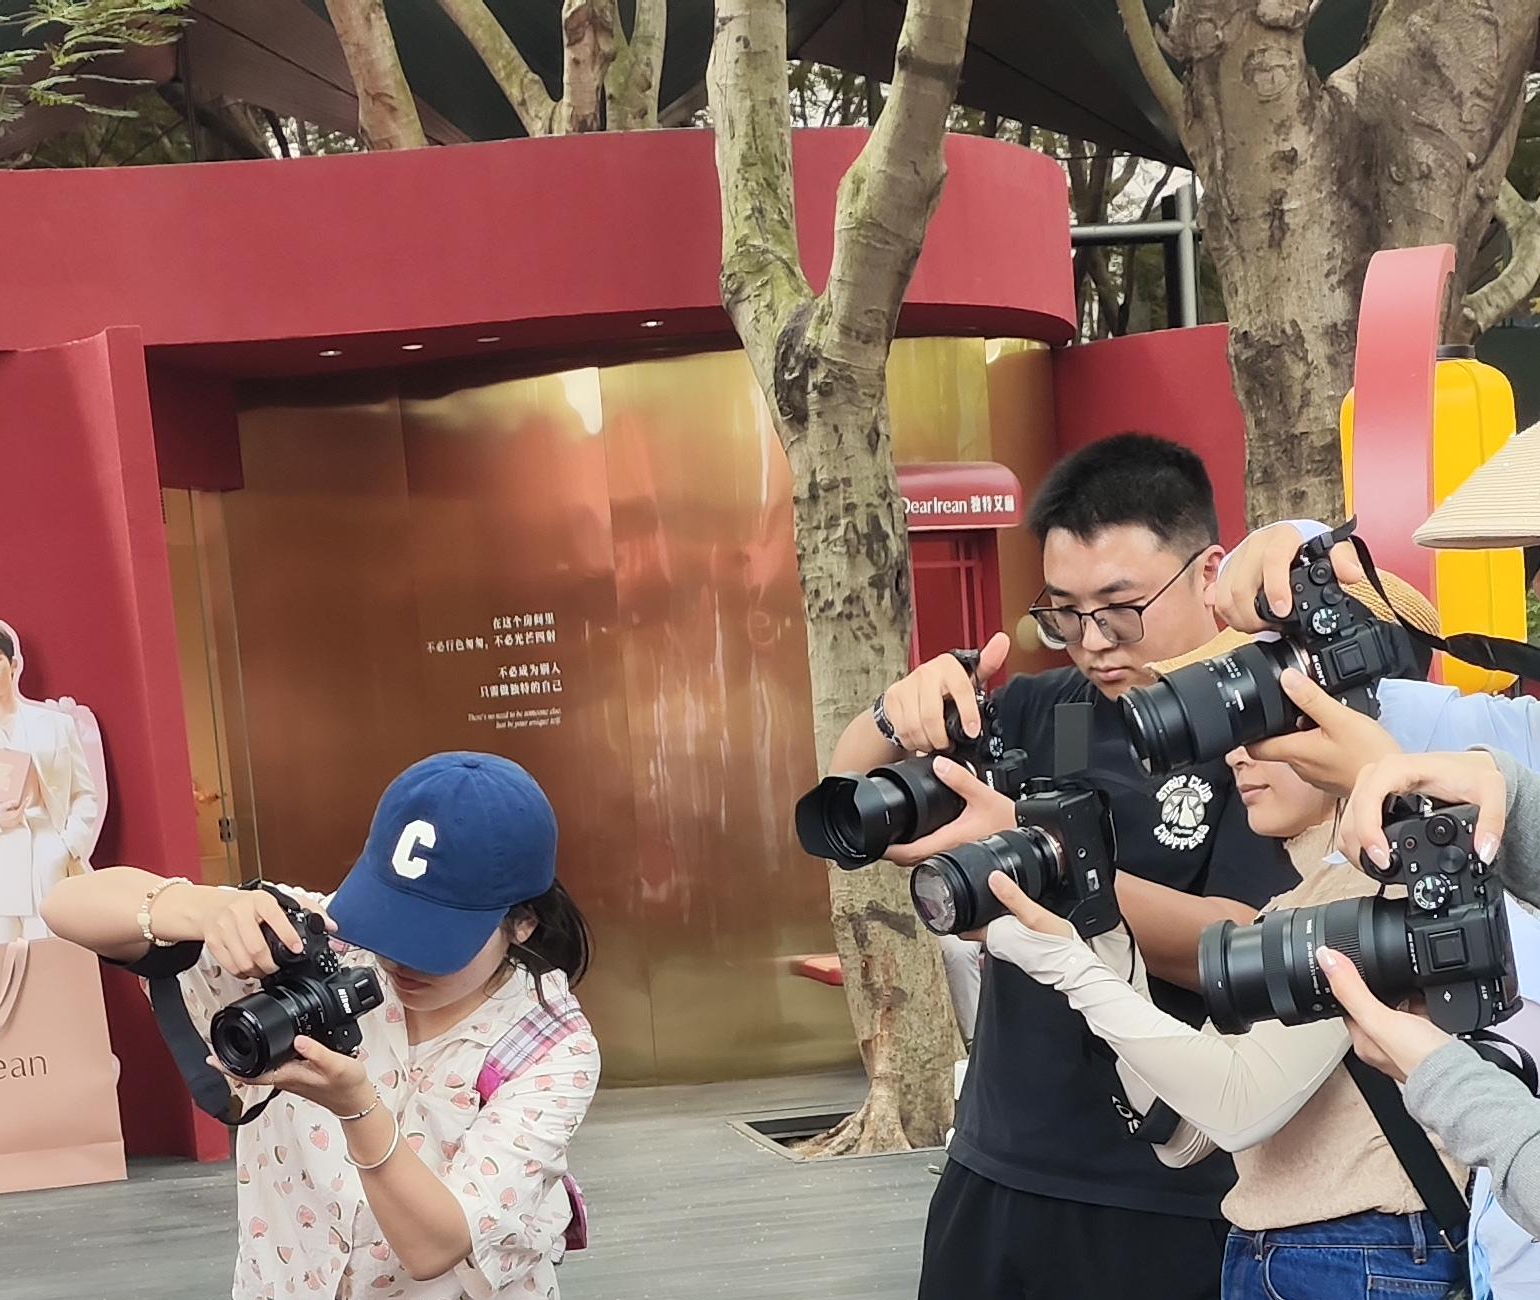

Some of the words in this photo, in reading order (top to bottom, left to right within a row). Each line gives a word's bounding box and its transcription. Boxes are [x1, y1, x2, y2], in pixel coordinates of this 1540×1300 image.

[492, 612, 555, 630] 在这个房间里
[498, 661, 561, 679] 不必成为别人
[1312, 654, 1328, 687] SONY
[479, 679, 563, 698] 只需做独特的自己
[1155, 774, 1187, 802] STRIP
[1188, 774, 1214, 803] CLUB
[391, 819, 437, 880] C
[1153, 823, 1210, 850] CHOPPERS
[337, 988, 352, 1014] Nikon
